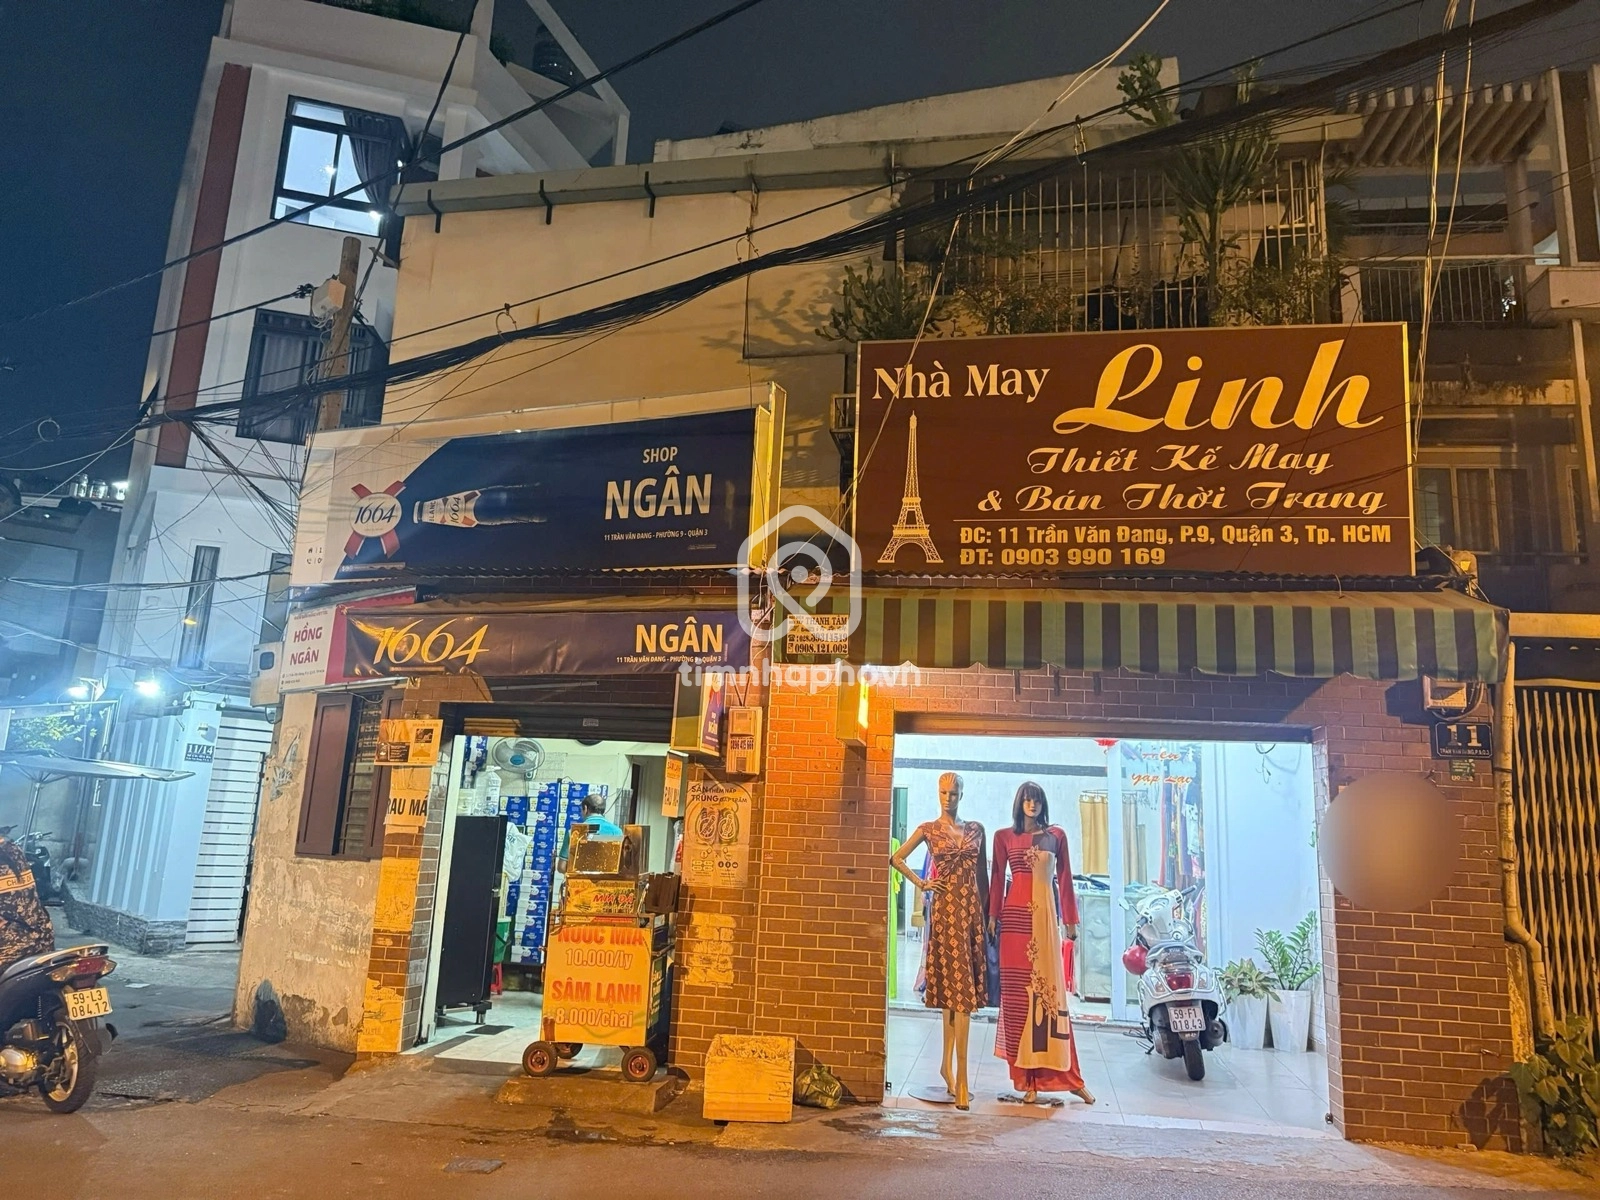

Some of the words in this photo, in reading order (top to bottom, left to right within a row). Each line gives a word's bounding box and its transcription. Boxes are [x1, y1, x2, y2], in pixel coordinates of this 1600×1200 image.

[872, 360, 951, 400] Nhà
[964, 363, 1051, 403] May
[1052, 338, 1384, 434] Linh
[642, 446, 678, 464] SHOP
[1026, 446, 1139, 475] Thiết
[1150, 444, 1222, 472] Kế
[1229, 442, 1334, 476] May
[605, 465, 712, 520] NGÂN
[977, 489, 1002, 513] &
[1015, 485, 1105, 512] Bán
[1122, 482, 1228, 511] Thời
[1246, 481, 1388, 515] Trang
[354, 501, 398, 525] 1664
[959, 526, 992, 544] ĐC:
[998, 526, 1018, 544] 11
[1026, 523, 1068, 544] Trần
[1074, 525, 1110, 543] Văn
[1116, 525, 1174, 545] Đang,
[1180, 525, 1215, 545] P.9,
[1221, 524, 1274, 547] Quận
[1280, 525, 1299, 545] 3,
[1305, 525, 1336, 545] Tp.
[1342, 525, 1391, 543] HCM
[959, 548, 993, 565] ĐT:
[1001, 548, 1060, 565] 0903
[1067, 548, 1112, 565] 990
[1120, 547, 1166, 565] 169
[293, 622, 323, 643] HỒNG
[373, 618, 490, 665] 1664
[635, 616, 723, 653] NGÂN
[289, 646, 319, 666] NGÂN
[795, 643, 848, 653] 0908.121.002
[1447, 724, 1482, 747] 11
[188, 744, 213, 755] 11/14
[409, 795, 429, 817] MÁ
[566, 949, 633, 970] 10.000/ly
[72, 989, 103, 1005] 59-L3
[551, 977, 591, 1002] SÂM
[596, 982, 642, 1006] LẠNH
[71, 1001, 109, 1018] 084.12
[555, 1008, 633, 1028] 8.000/chai
[1172, 1018, 1203, 1031] 018.43
